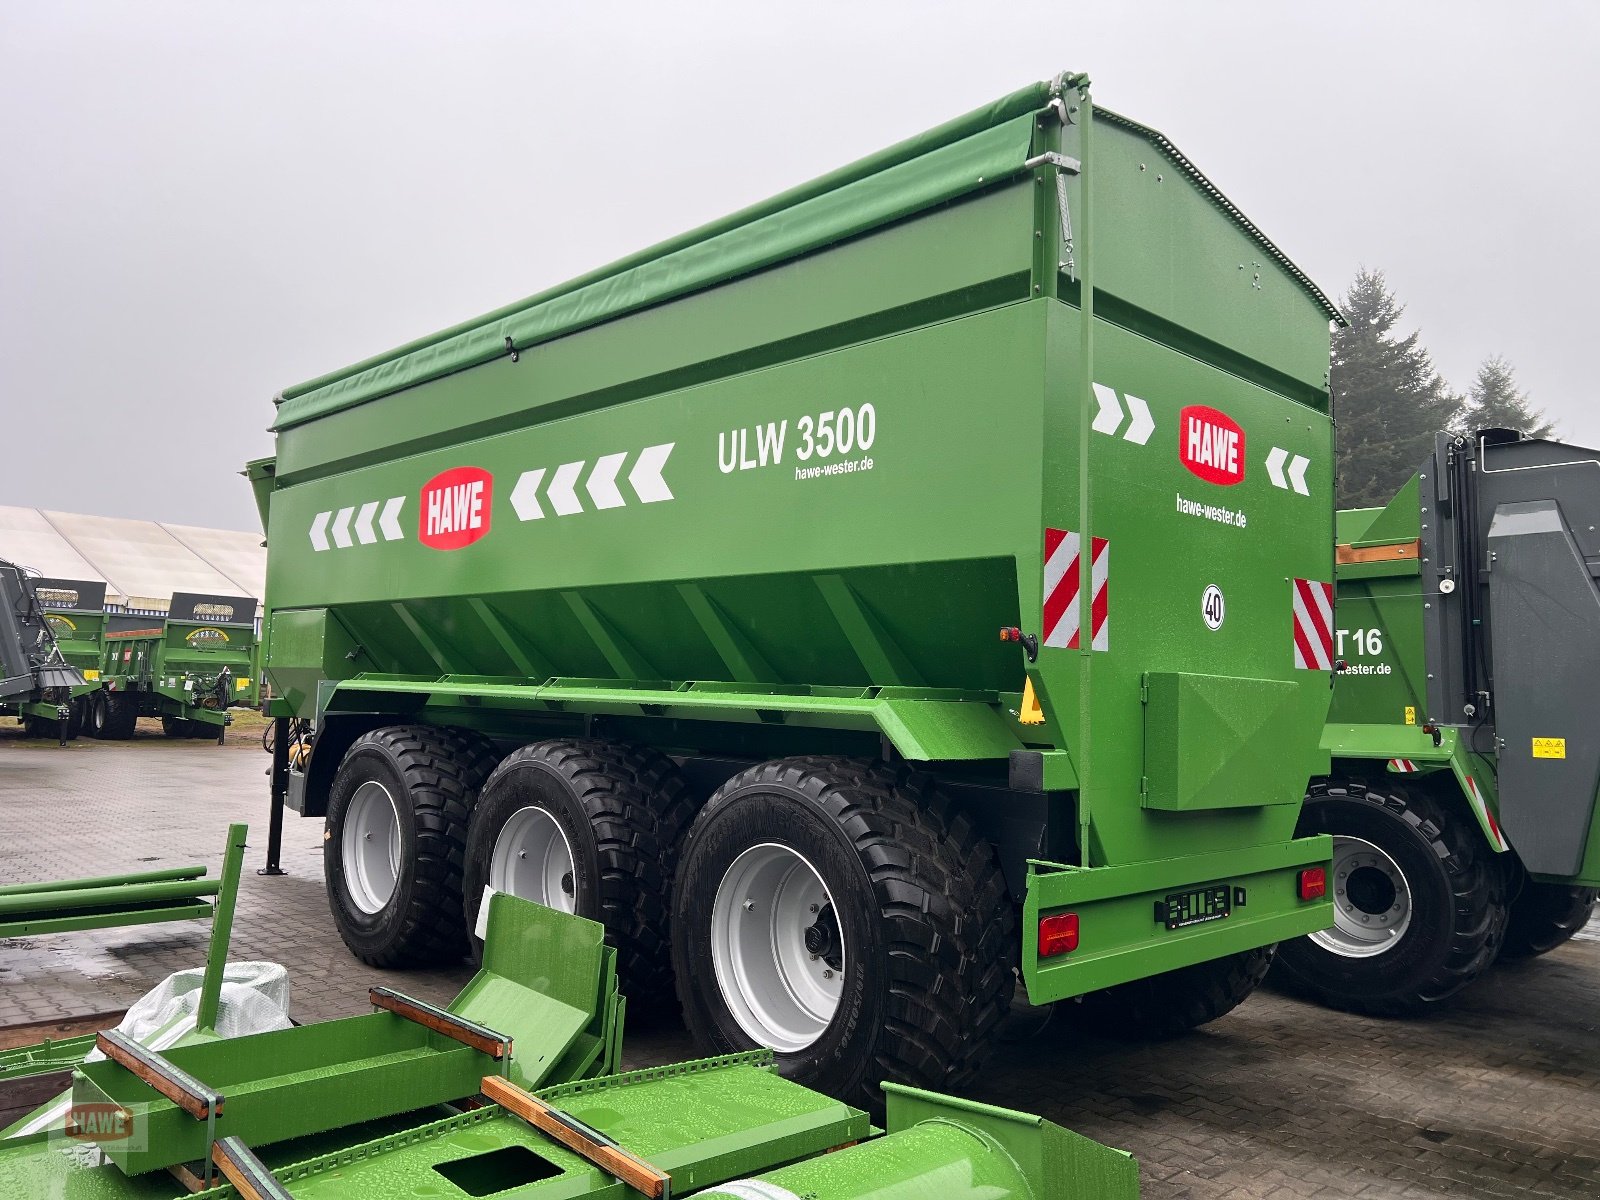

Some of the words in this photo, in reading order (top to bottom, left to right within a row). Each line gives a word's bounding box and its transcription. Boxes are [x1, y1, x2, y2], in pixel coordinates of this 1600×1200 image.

[718, 419, 787, 474] ULW
[796, 402, 876, 461] 3500
[1187, 416, 1239, 475] HAWE
[795, 455, 874, 480] hawe-wester.de
[427, 480, 484, 536] HAWE
[1176, 492, 1247, 528] hawe-wester.de
[1205, 593, 1221, 622] 40
[1352, 628, 1383, 656] 16
